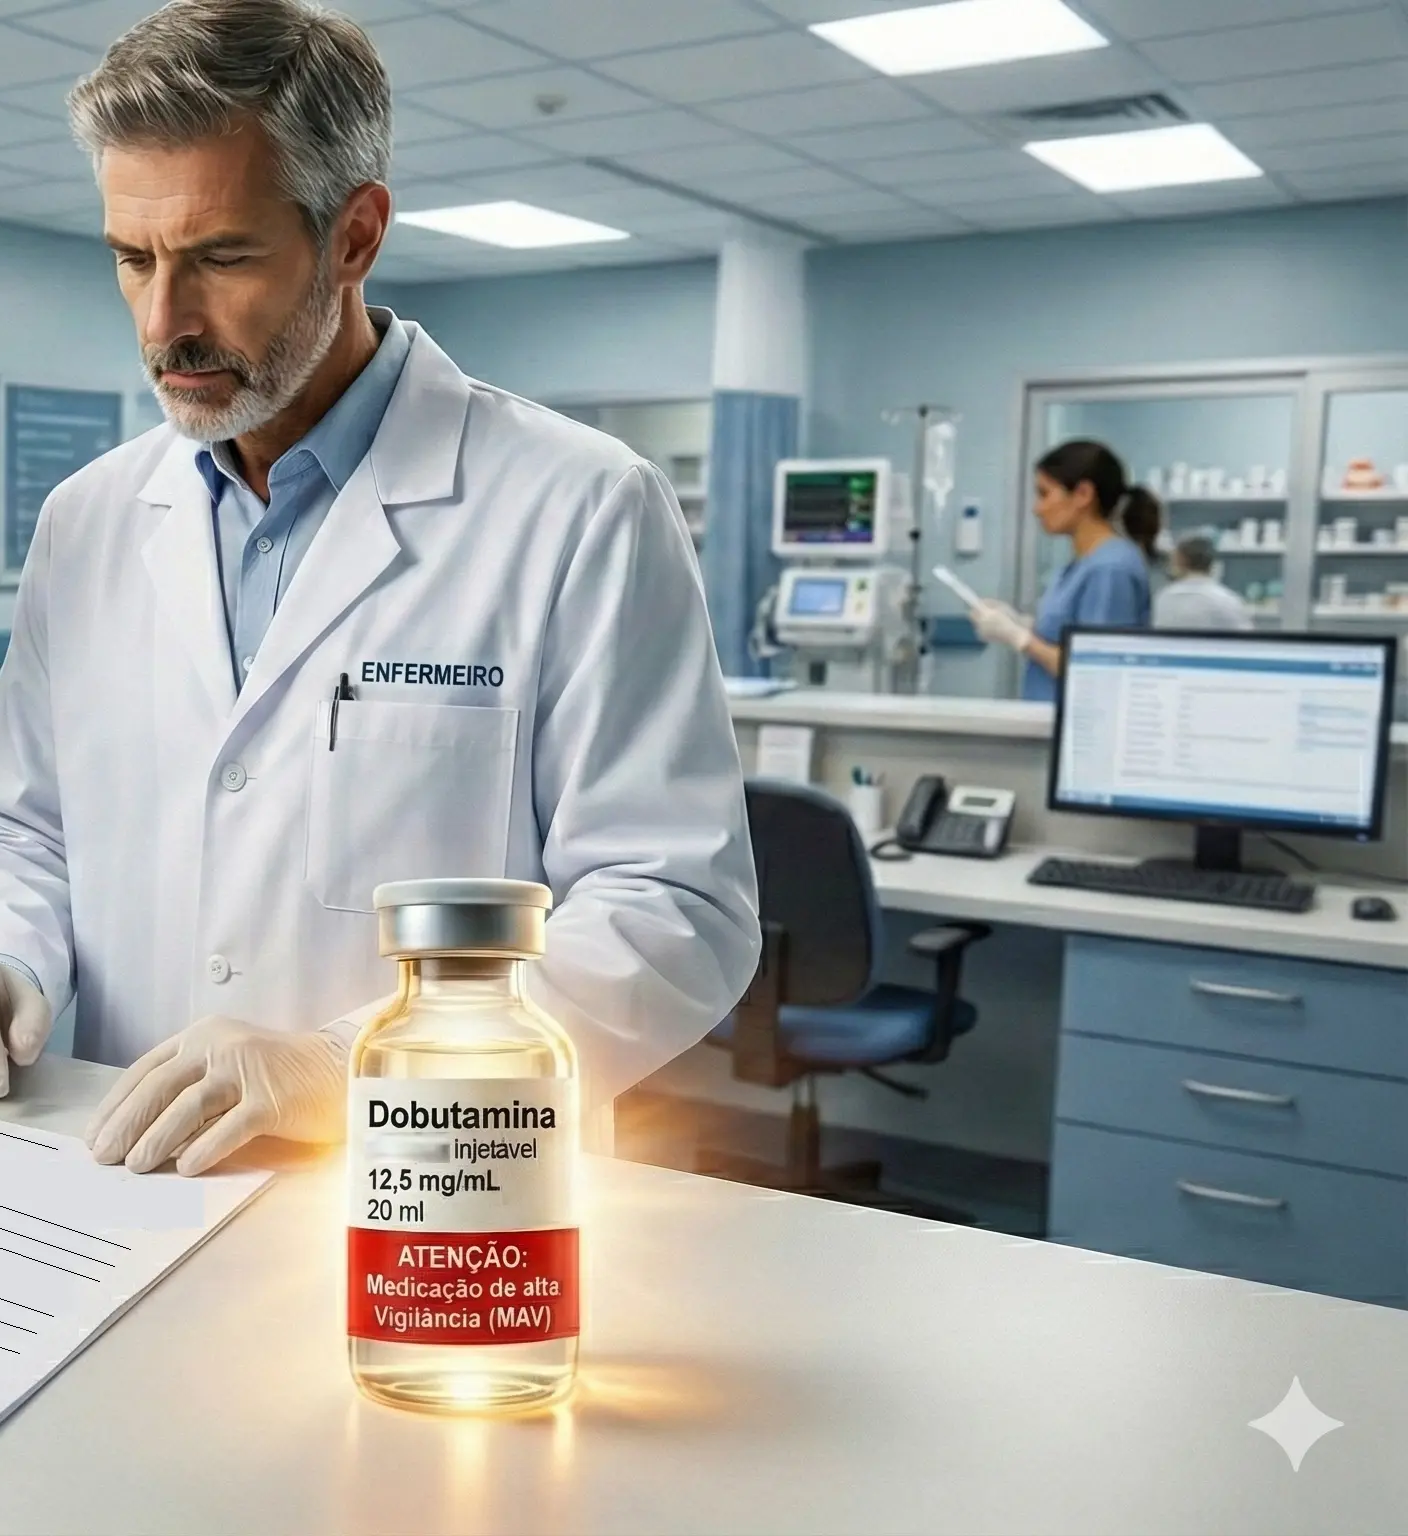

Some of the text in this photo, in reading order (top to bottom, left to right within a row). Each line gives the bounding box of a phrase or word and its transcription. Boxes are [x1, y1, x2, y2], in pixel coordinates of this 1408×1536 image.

[361, 661, 504, 688] ENFERMEIRO
[368, 1100, 556, 1129] Dobutamina
[454, 1138, 537, 1164] injetável
[368, 1169, 501, 1196] 12,5 mg/mL
[367, 1199, 424, 1222] 20 ml
[397, 1240, 528, 1274] ATENÇÃO:
[366, 1273, 560, 1303] Medicação de alta
[374, 1305, 551, 1334] Vigilância (MAV)
